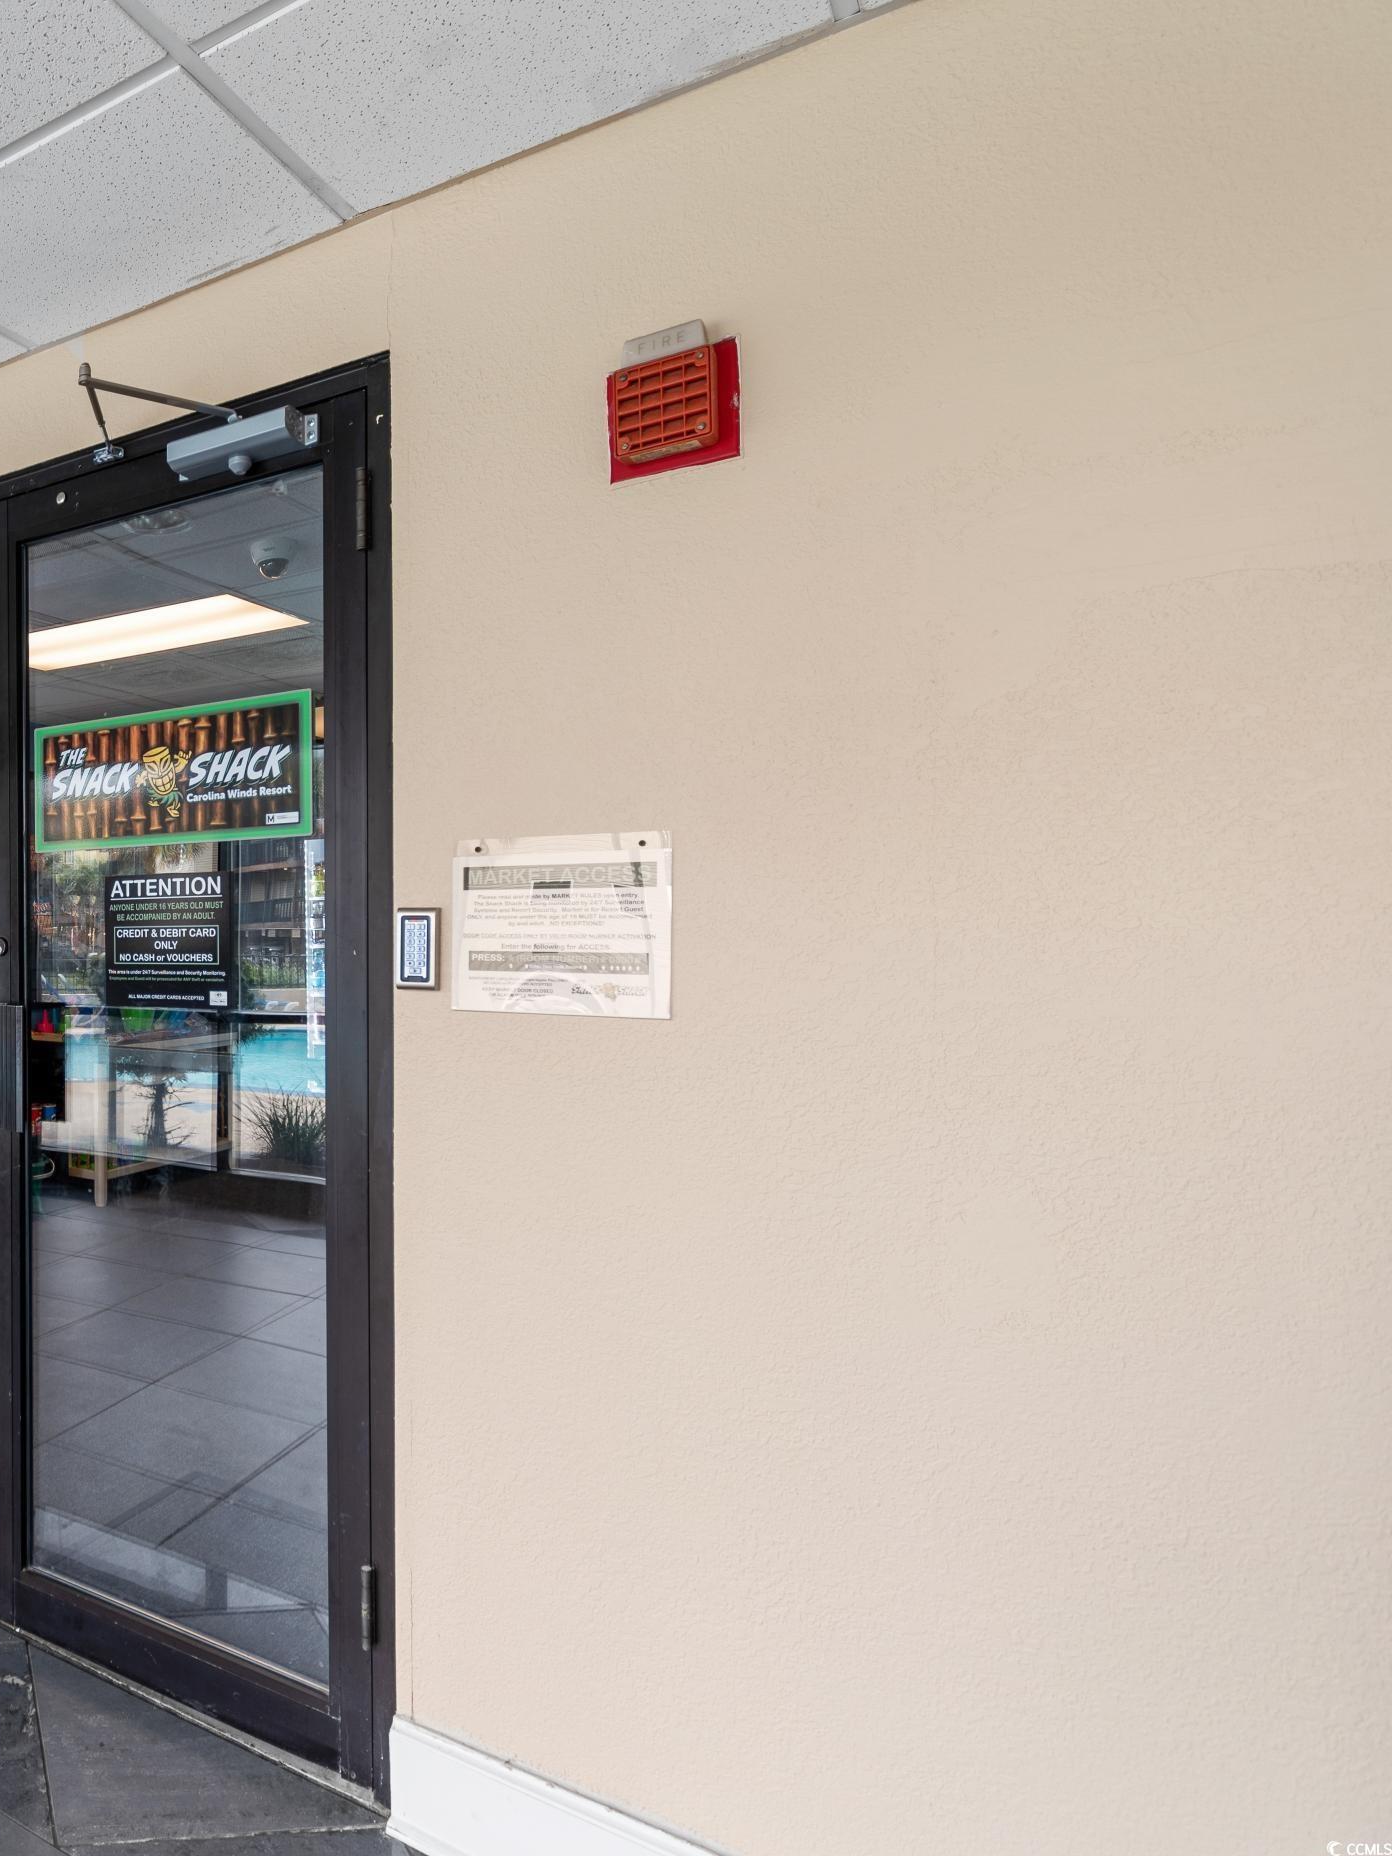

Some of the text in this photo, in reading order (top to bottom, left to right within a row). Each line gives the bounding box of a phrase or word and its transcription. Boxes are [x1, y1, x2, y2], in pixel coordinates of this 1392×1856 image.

[638, 330, 685, 355] FIRE
[59, 747, 87, 767] THE
[51, 744, 291, 800] SNACK SHACK
[186, 784, 292, 803] Carolina Winds Resort
[469, 864, 653, 885] MARKET ACCESS
[110, 876, 221, 898] ATTENTION
[109, 903, 135, 912] ANYONE
[136, 903, 158, 911] UNDER
[168, 902, 188, 910] YEARS
[189, 901, 204, 910] OLD
[204, 901, 224, 909] MUST
[116, 911, 215, 922] BE ACCOMPANIED BY AN ADULT.
[116, 927, 216, 938] CREDIT & DEBIT CARD
[154, 941, 178, 950] ONLY
[119, 953, 132, 962] NO
[132, 953, 155, 962] CASH
[166, 953, 213, 962] VOUCHERS
[471, 953, 505, 961] PRESS:
